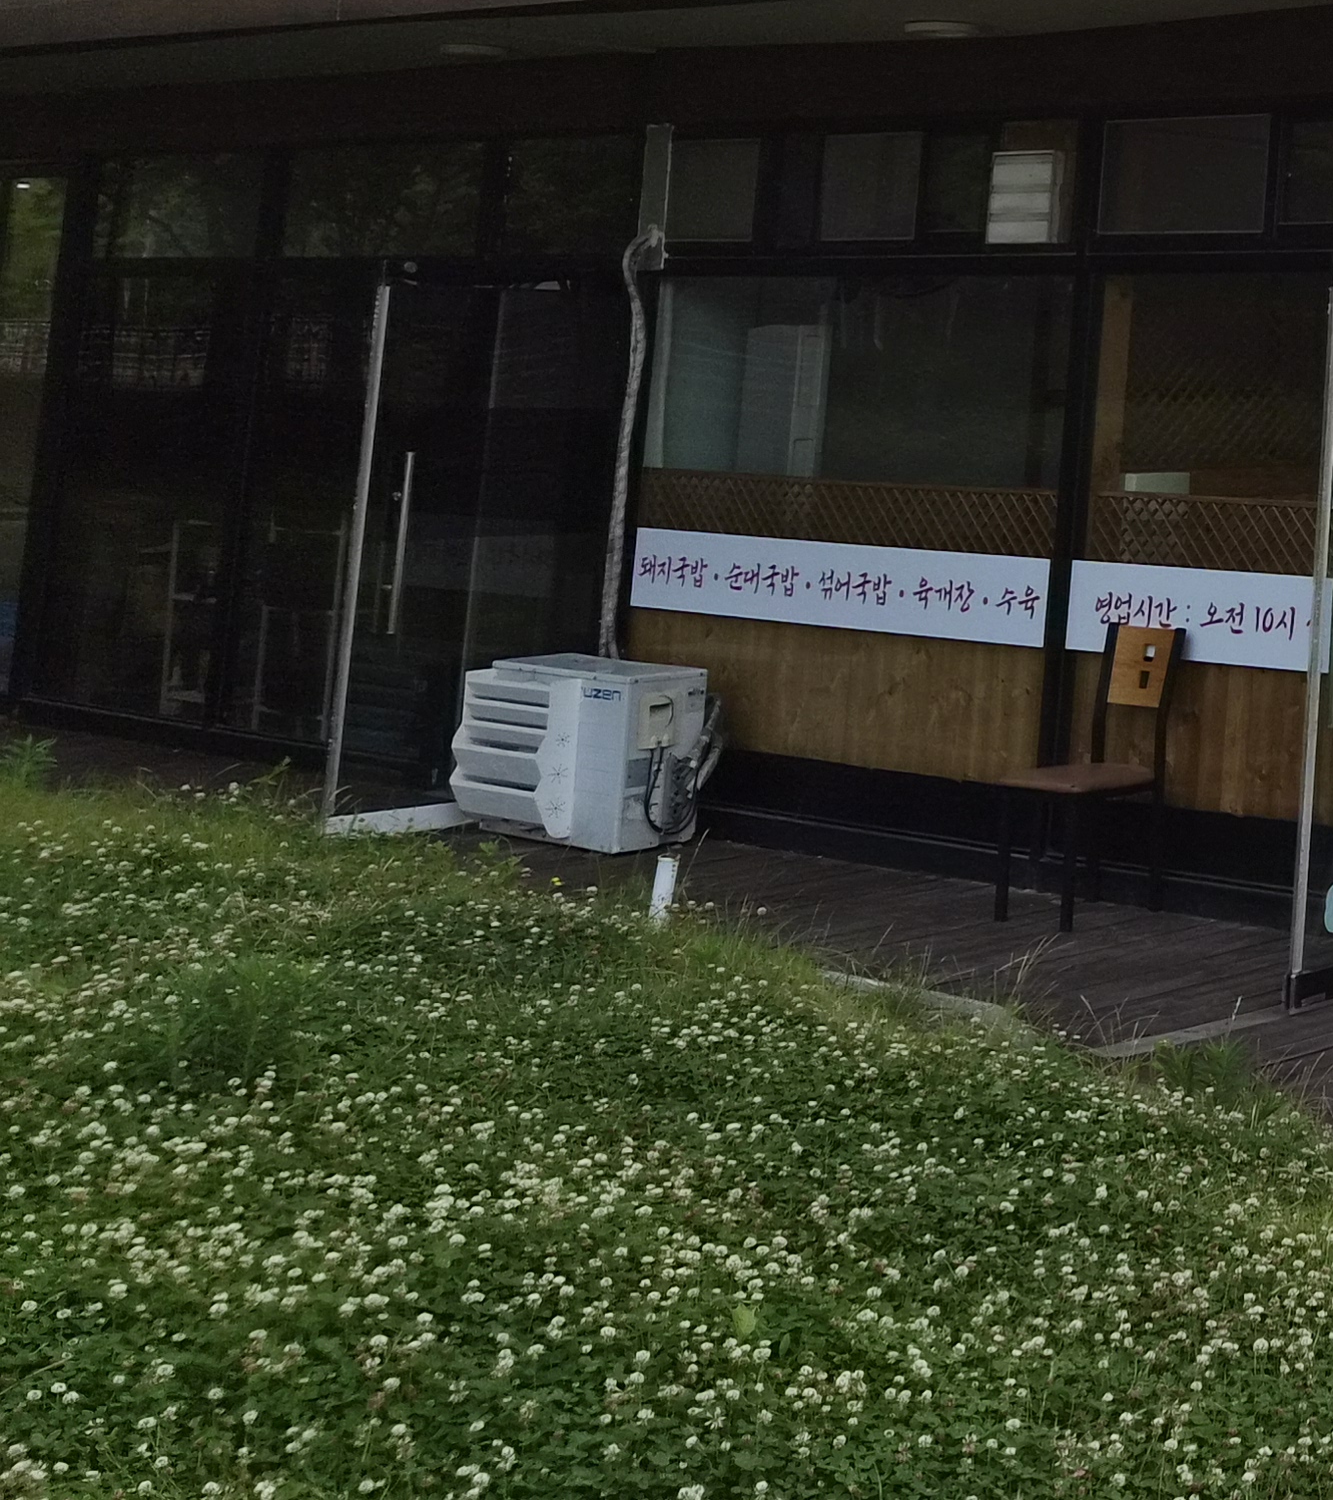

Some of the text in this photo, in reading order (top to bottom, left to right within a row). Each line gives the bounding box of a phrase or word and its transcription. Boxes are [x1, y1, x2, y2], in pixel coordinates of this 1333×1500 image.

[638, 554, 1041, 619] 돼지국밥 순대국밥 섞어국밥 육개장 수육
[1094, 591, 1178, 629] 영업시간
[1199, 602, 1245, 635] 오전
[1254, 606, 1296, 641] 10시
[581, 686, 622, 702] uzen
